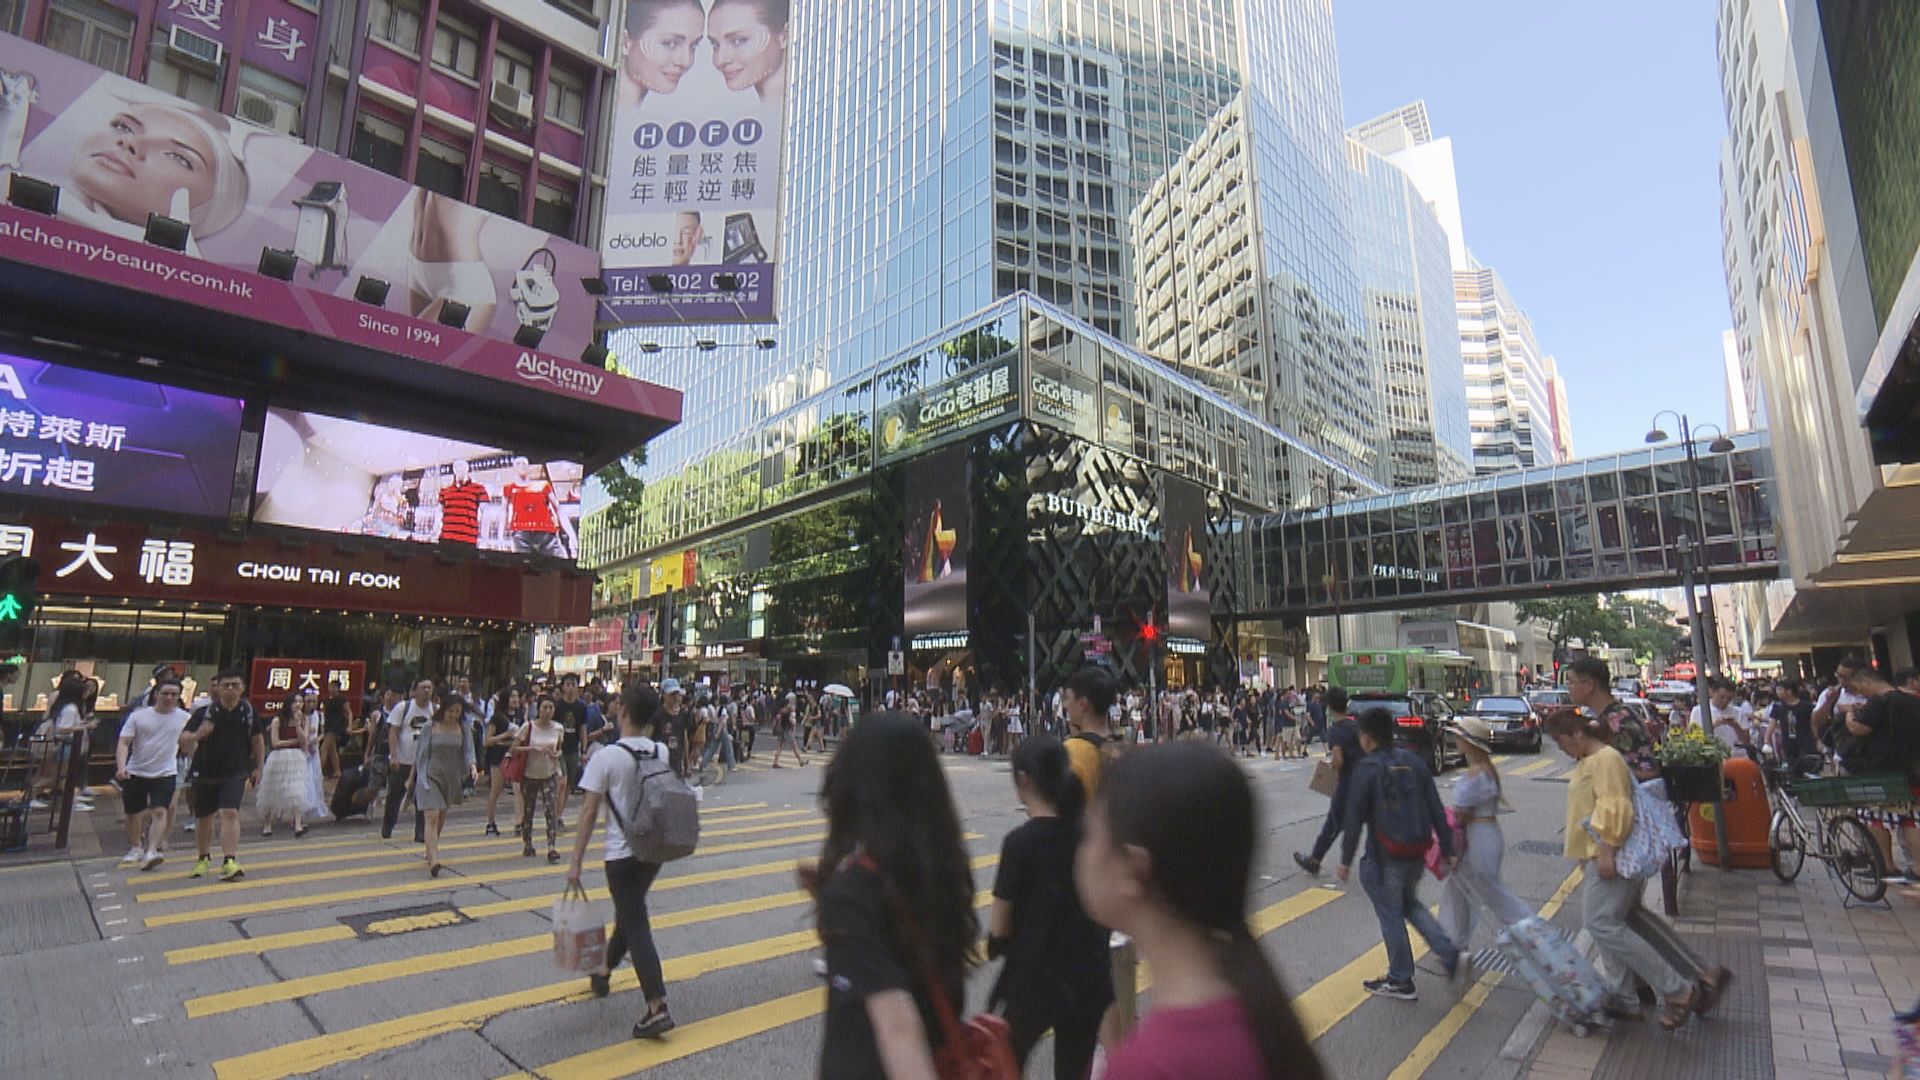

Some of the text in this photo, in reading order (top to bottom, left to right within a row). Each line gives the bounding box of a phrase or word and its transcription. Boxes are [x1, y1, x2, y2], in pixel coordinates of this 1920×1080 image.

[637, 121, 758, 147] HIFU
[632, 151, 758, 177] 能量聚焦
[630, 178, 756, 204] 年輕逆轉
[611, 276, 645, 293] Tel:
[710, 271, 759, 291] 002
[358, 314, 441, 347] Since 1994
[516, 352, 604, 395] Alchemy
[1046, 493, 1149, 538] BURBERRY
[237, 562, 401, 590] CHOW TAI FOOK
[911, 636, 968, 650] BURBERRY
[267, 667, 350, 691] 周大福
